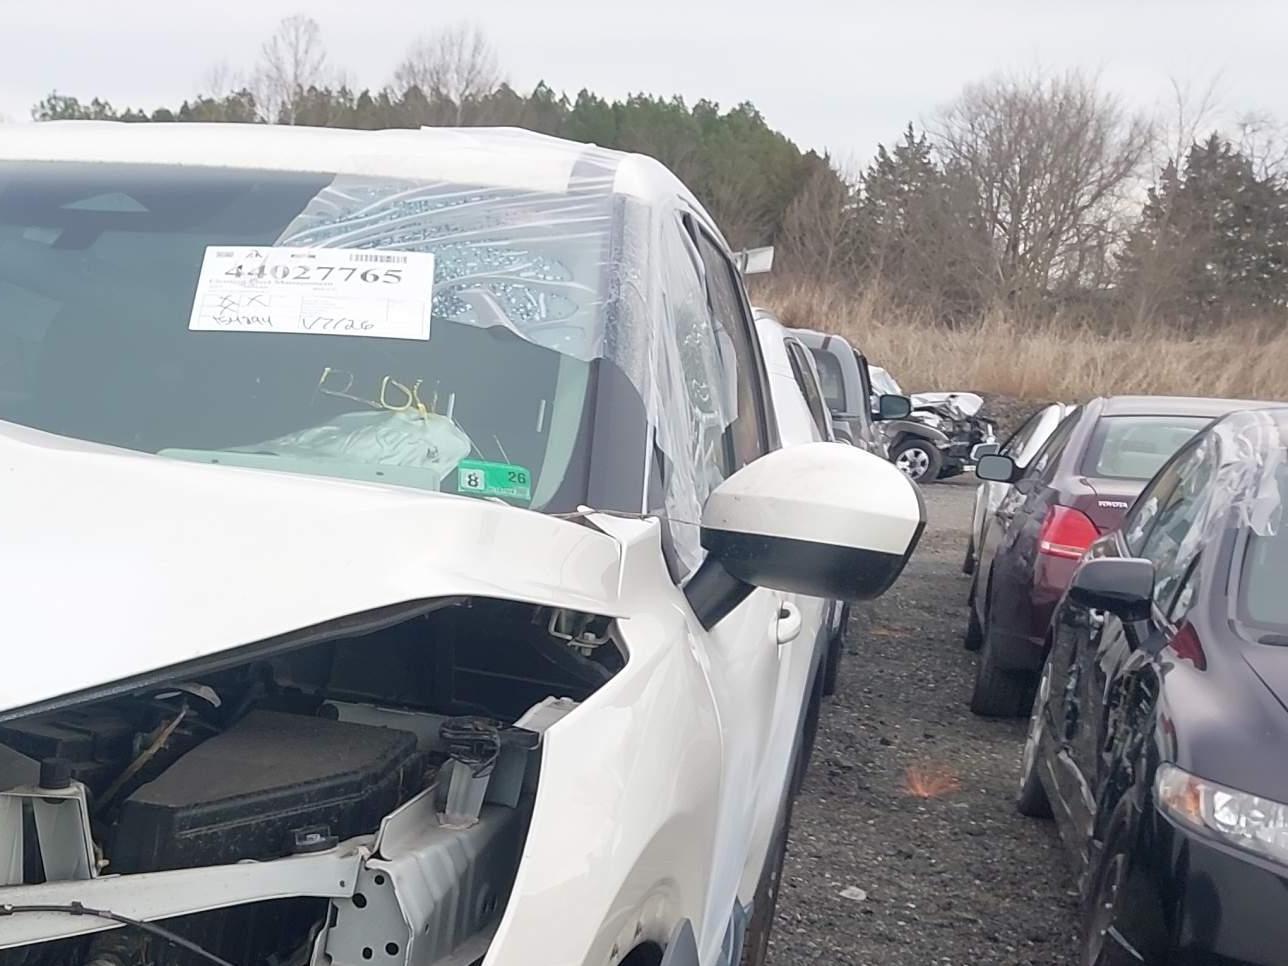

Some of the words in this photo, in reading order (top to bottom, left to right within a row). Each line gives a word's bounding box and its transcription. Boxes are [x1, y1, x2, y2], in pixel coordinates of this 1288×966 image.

[225, 264, 403, 284] 44027765
[467, 472, 479, 487] 8
[508, 471, 527, 484] 26
